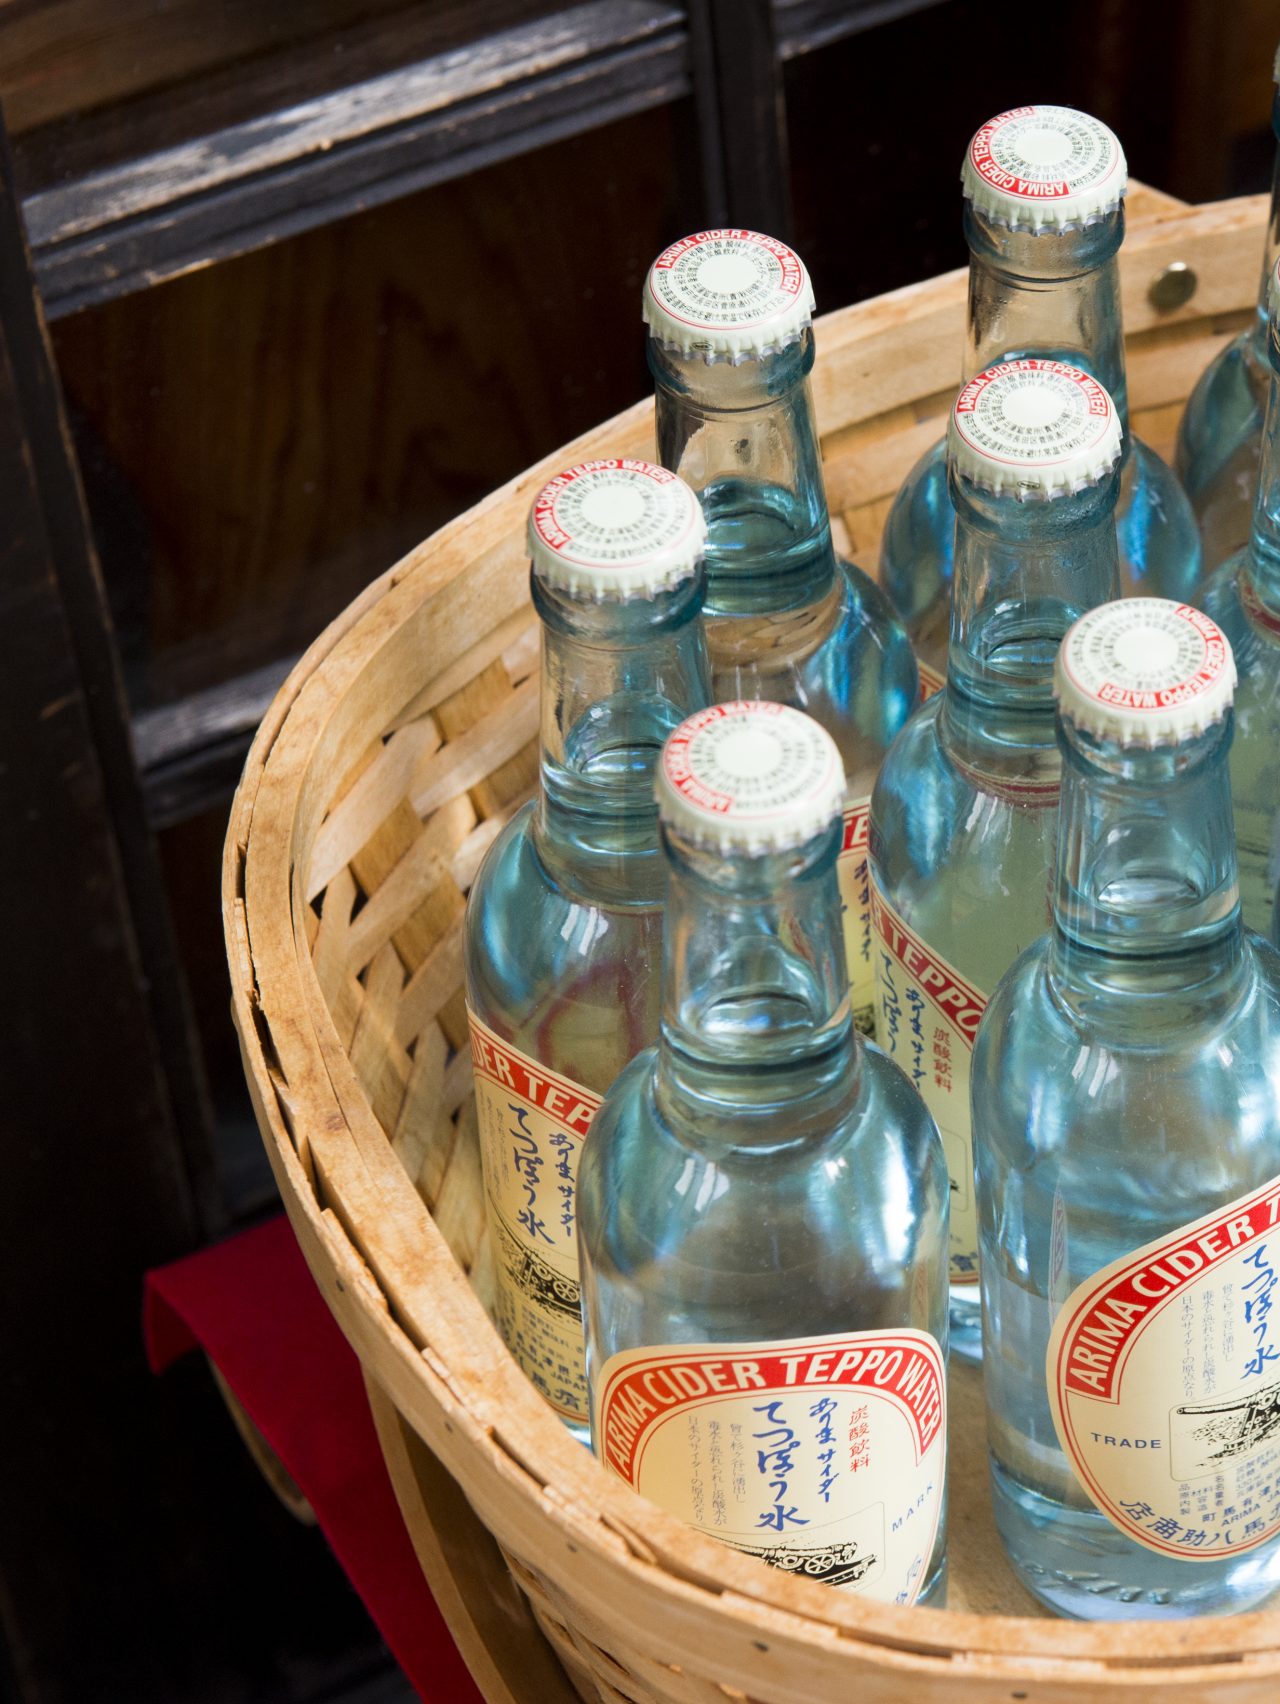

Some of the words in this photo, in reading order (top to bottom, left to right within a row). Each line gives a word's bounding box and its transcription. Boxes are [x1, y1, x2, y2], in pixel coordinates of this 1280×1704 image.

[989, 106, 1032, 128] WATER
[975, 127, 993, 161] TEPPO
[980, 160, 1015, 188] CIDER
[1018, 180, 1064, 195] ARIMA
[658, 238, 695, 267] ARIMA
[696, 230, 741, 242] CIDER
[747, 231, 788, 256] TEPPO
[784, 256, 800, 292] WATER
[959, 379, 988, 411] ARIMA
[986, 361, 1030, 379] CIDER
[1035, 361, 1082, 380] TEPPO
[1079, 379, 1106, 415] WATER
[567, 460, 617, 478] TEPPO
[622, 460, 673, 482] WATER
[538, 477, 568, 507] CIDER
[536, 512, 567, 545] ARIMA
[524, 1071, 592, 1124] TEP
[1069, 1300, 1145, 1391] ARIMA
[1131, 1217, 1255, 1300] CIDER
[607, 1384, 657, 1476] ARIMA
[643, 1362, 766, 1403] CIDER
[780, 1350, 903, 1385] TEPPO
[896, 1354, 941, 1447] WATER
[849, 1405, 870, 1472] 炭酸飲料
[1091, 1432, 1162, 1449] TRADE
[1221, 1503, 1261, 1527] ARIMA
